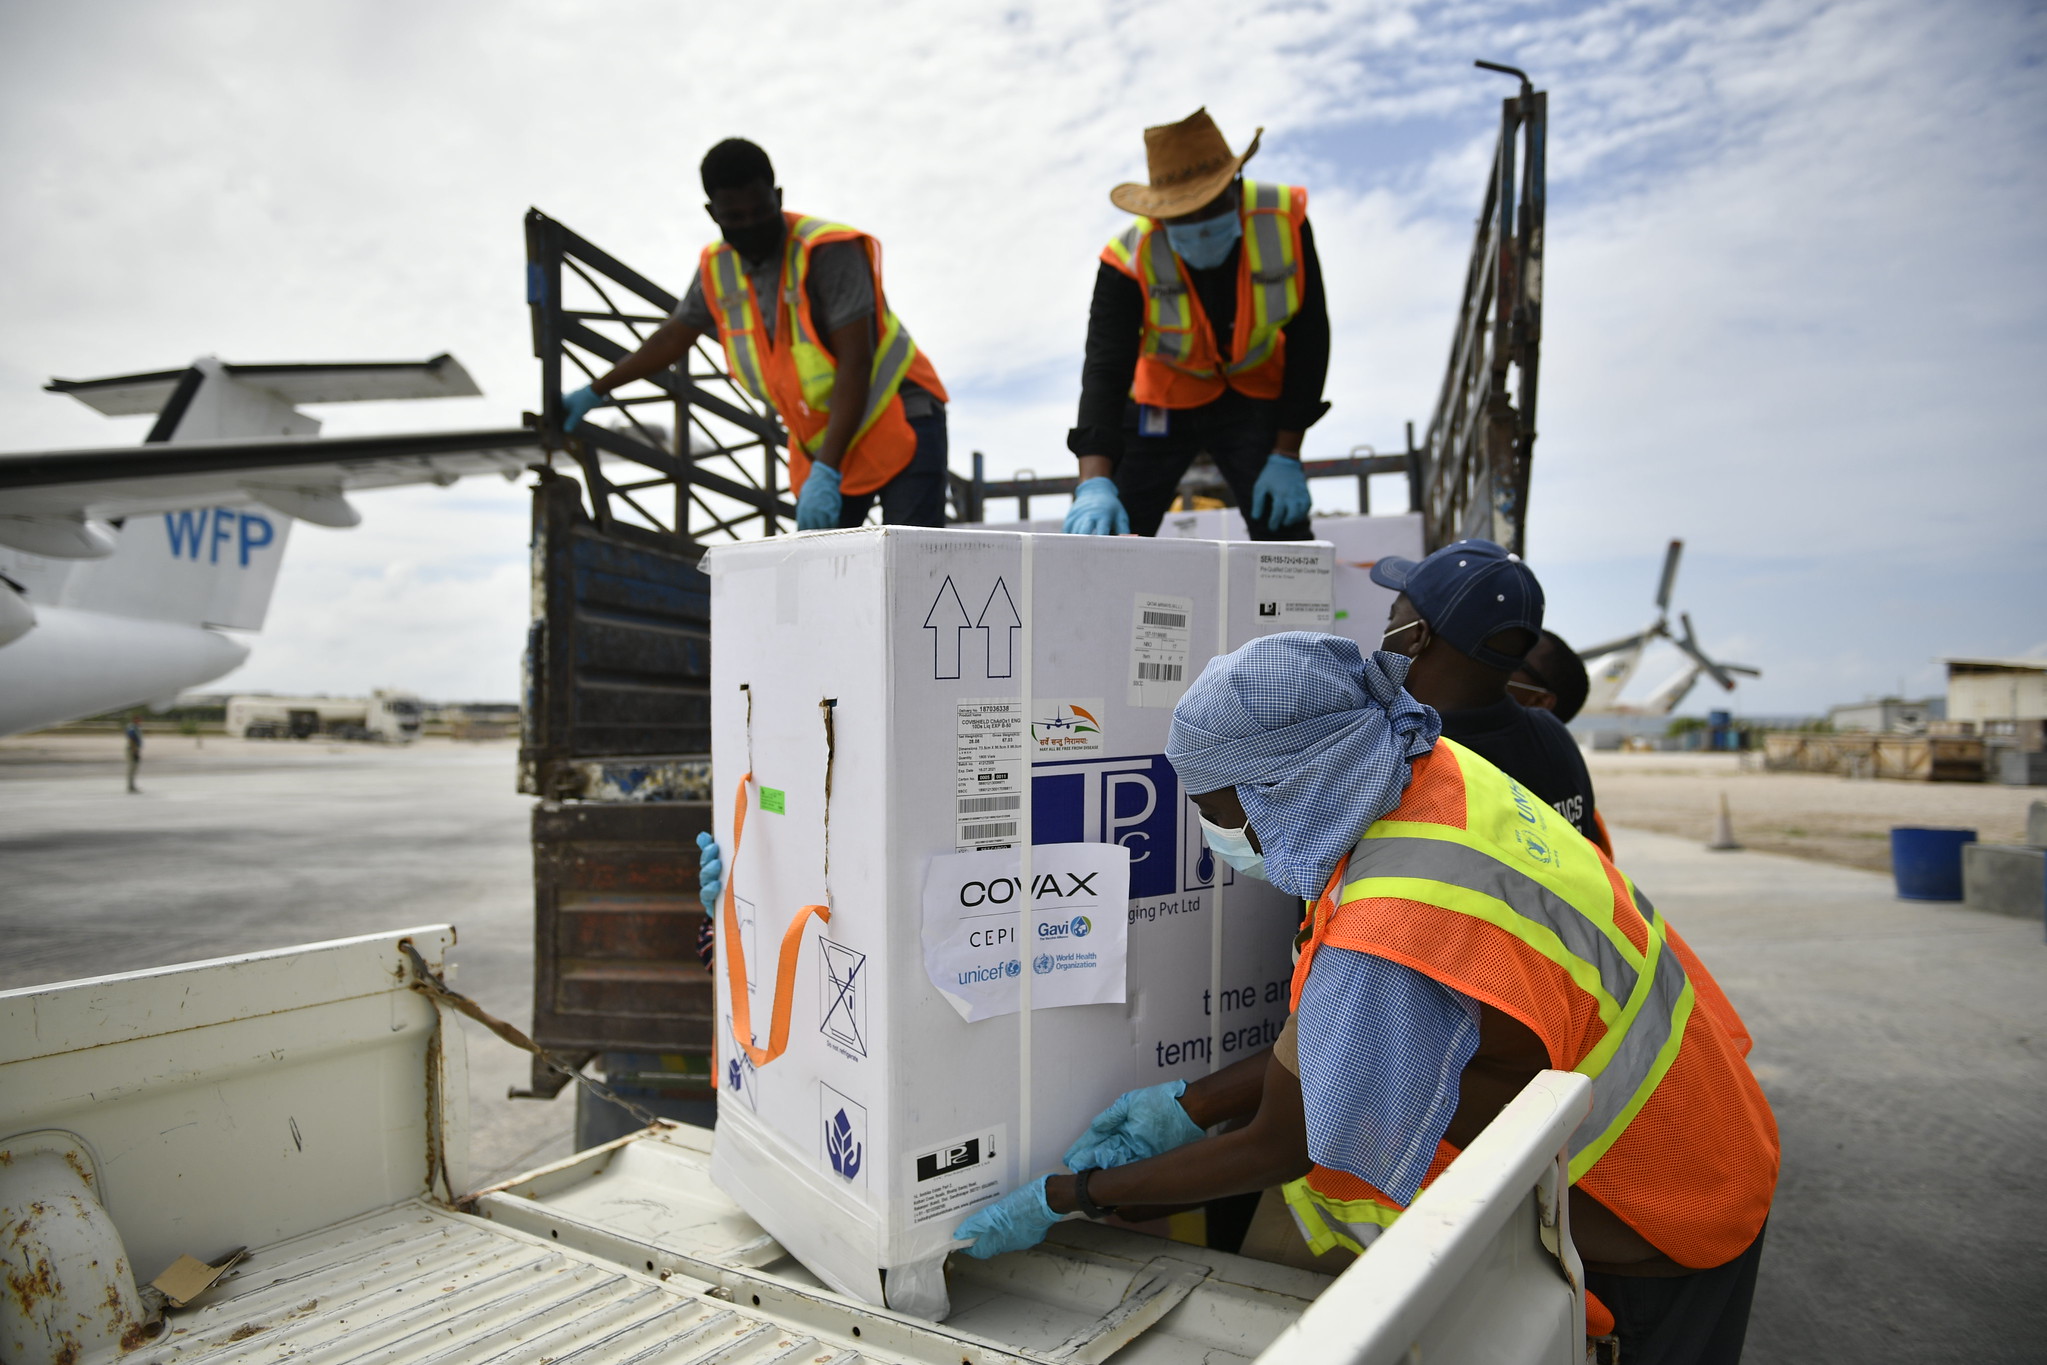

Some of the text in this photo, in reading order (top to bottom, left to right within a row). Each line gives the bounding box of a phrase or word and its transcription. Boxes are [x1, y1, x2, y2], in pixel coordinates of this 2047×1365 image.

[164, 508, 274, 569] WFP
[960, 872, 1099, 907] COVAX
[1159, 900, 1179, 917] Pvt
[1182, 896, 1200, 913] Ltd
[969, 927, 1014, 948] CEPI
[1038, 921, 1069, 938] Gavi
[1056, 952, 1097, 962] World Health
[1056, 961, 1097, 971] Organization
[958, 962, 1004, 985] unicef
[1203, 986, 1256, 1015] tme
